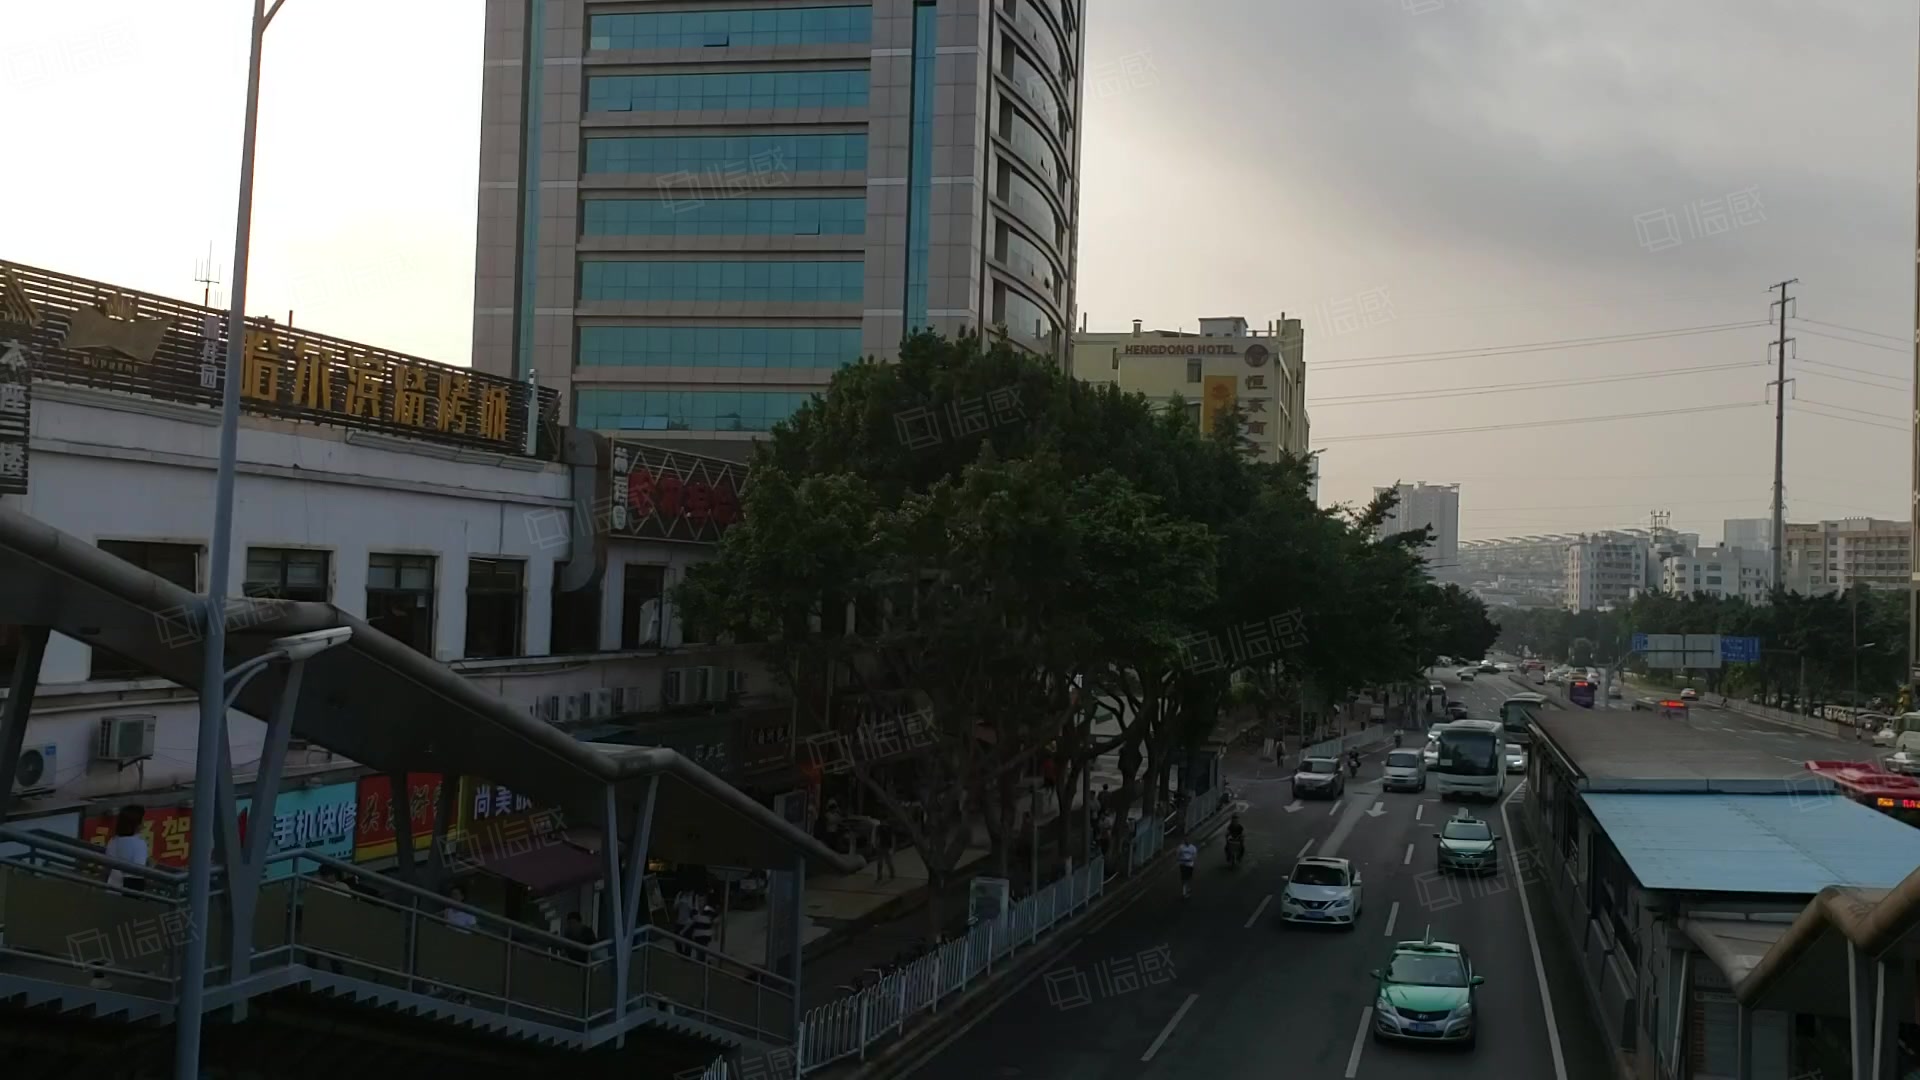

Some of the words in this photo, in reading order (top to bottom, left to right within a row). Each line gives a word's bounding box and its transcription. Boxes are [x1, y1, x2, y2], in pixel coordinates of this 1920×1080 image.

[1125, 345, 1194, 355] HENGDONG
[1197, 345, 1237, 355] HOTEL
[273, 802, 357, 846] 手机快修
